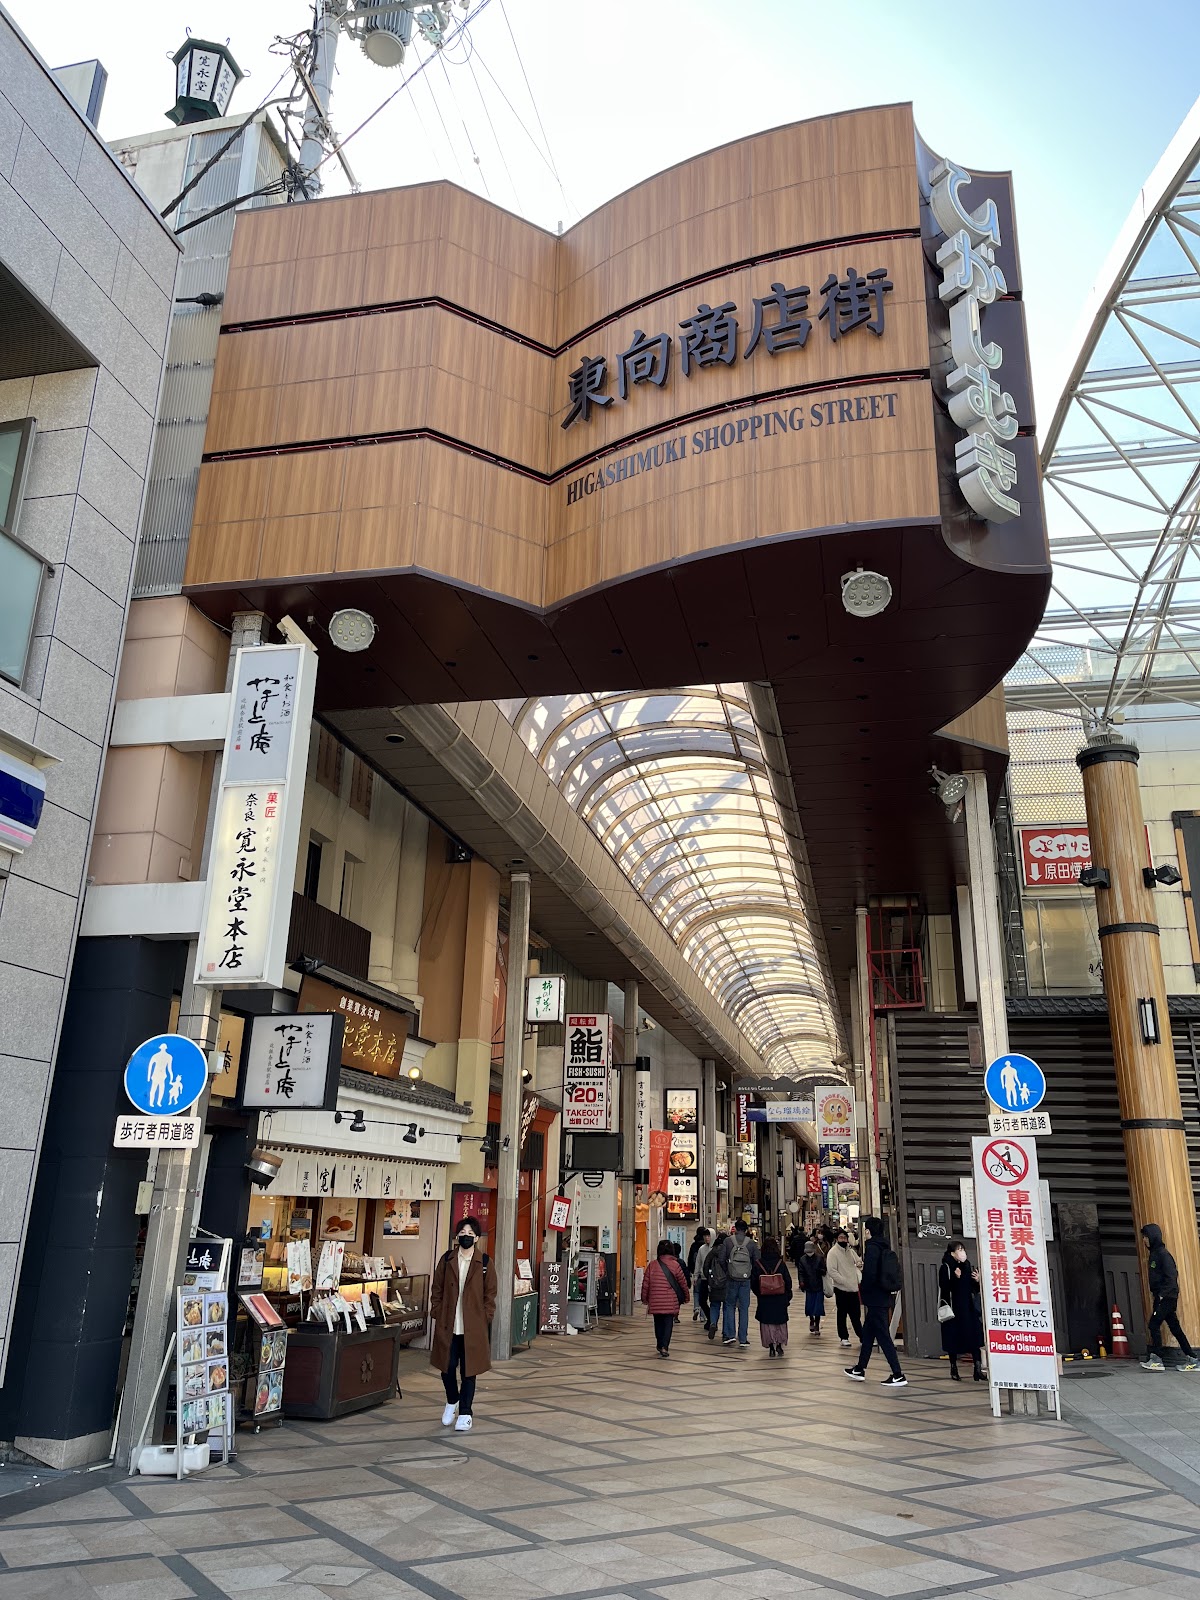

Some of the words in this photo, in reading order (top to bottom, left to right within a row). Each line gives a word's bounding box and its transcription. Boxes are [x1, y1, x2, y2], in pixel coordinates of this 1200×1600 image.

[195, 55, 211, 93] 寛永堂
[560, 267, 894, 430] 東向商店街
[928, 158, 1021, 523] ひがしむき
[566, 435, 687, 507] HIGASHIMUKI
[691, 406, 805, 456] SHOPPING
[810, 392, 899, 428] STREET
[246, 677, 281, 755] やまと庵
[244, 792, 259, 822] 奈良
[264, 792, 279, 818] 菓匠
[218, 827, 257, 969] 寛永堂本店
[569, 1027, 603, 1064] 鮨
[274, 1024, 303, 1099] やまと庵
[566, 1109, 604, 1117] TAKEOUT
[768, 1106, 811, 1115] なら瑠璃絵
[993, 1116, 1047, 1132] 歩行者用道路
[120, 1121, 195, 1141] 歩行者用道路
[986, 1208, 1012, 1303] 自行車請推行
[1006, 1189, 1041, 1305] 車両乗入禁止
[547, 1263, 562, 1295] 柿の葉
[547, 1303, 561, 1325] 茶屋
[991, 1308, 1047, 1318] 自転車は押して
[991, 1318, 1049, 1329] 通行して下さい
[990, 1341, 1016, 1351] Please
[1017, 1343, 1054, 1353] Dismount
[1005, 1333, 1036, 1343] Cyclists
